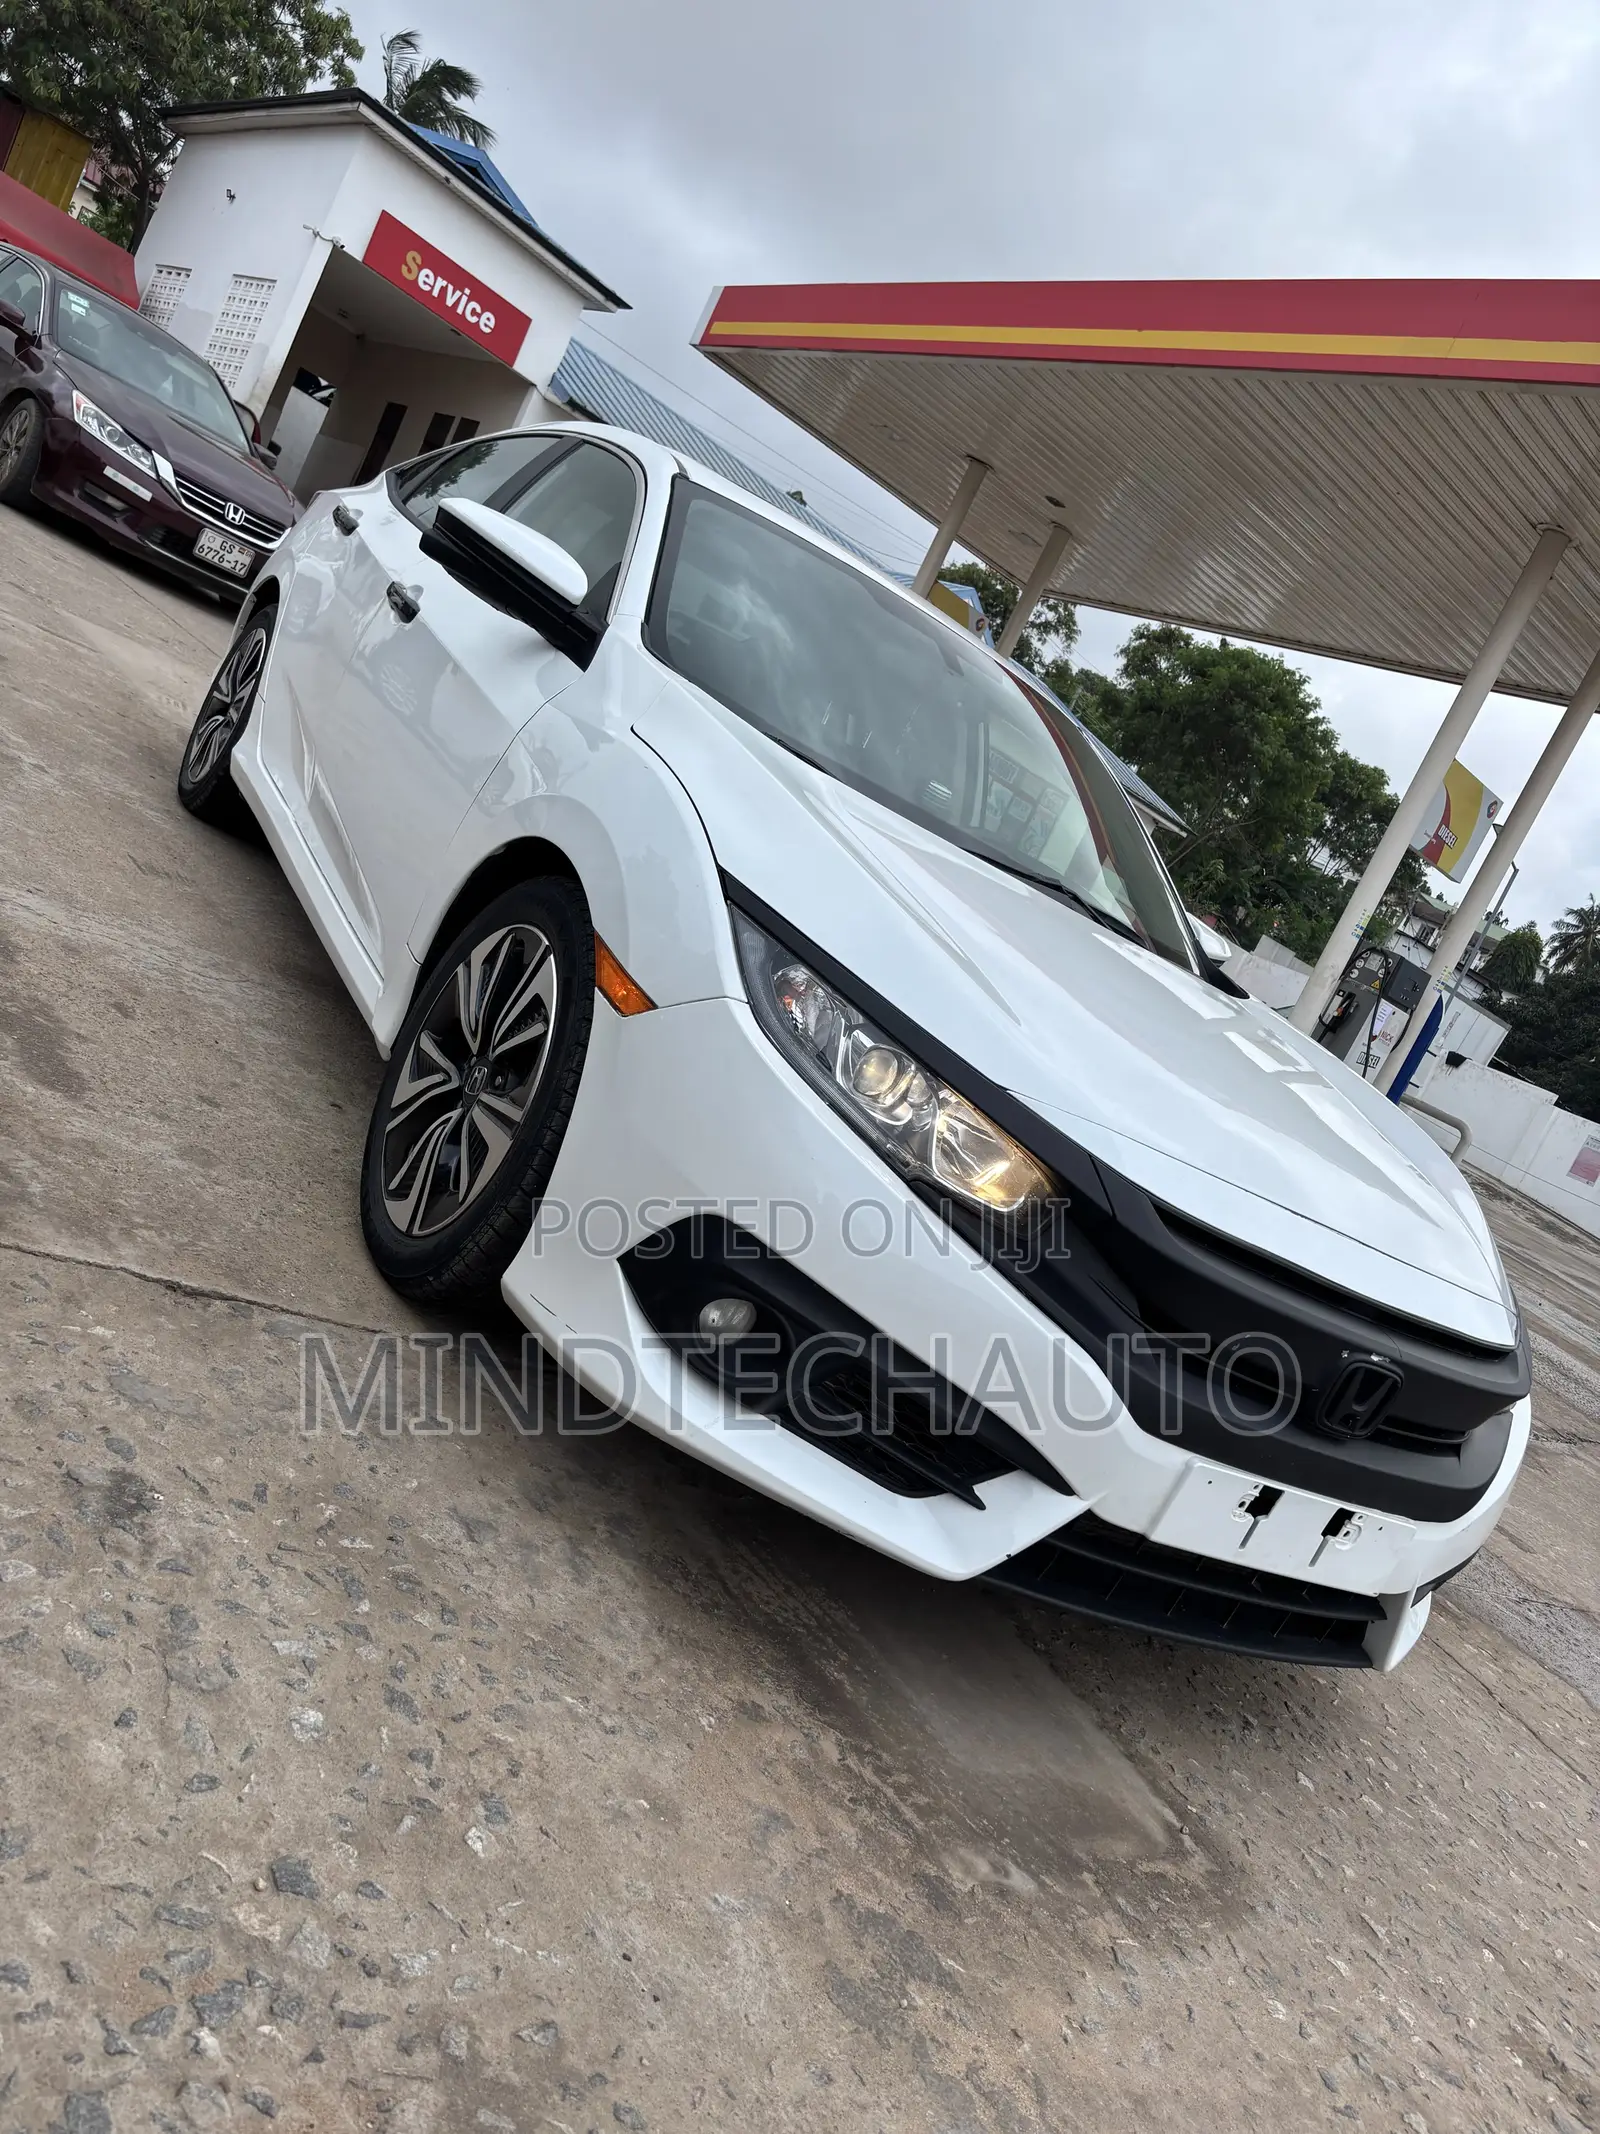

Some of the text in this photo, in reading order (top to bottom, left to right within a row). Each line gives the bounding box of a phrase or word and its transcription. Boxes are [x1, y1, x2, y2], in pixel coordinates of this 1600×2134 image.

[401, 250, 496, 334] Service
[198, 543, 247, 572] 6776-17
[220, 540, 235, 554] GS
[1438, 824, 1457, 848] DIESEL
[1358, 1052, 1379, 1068] DISEL
